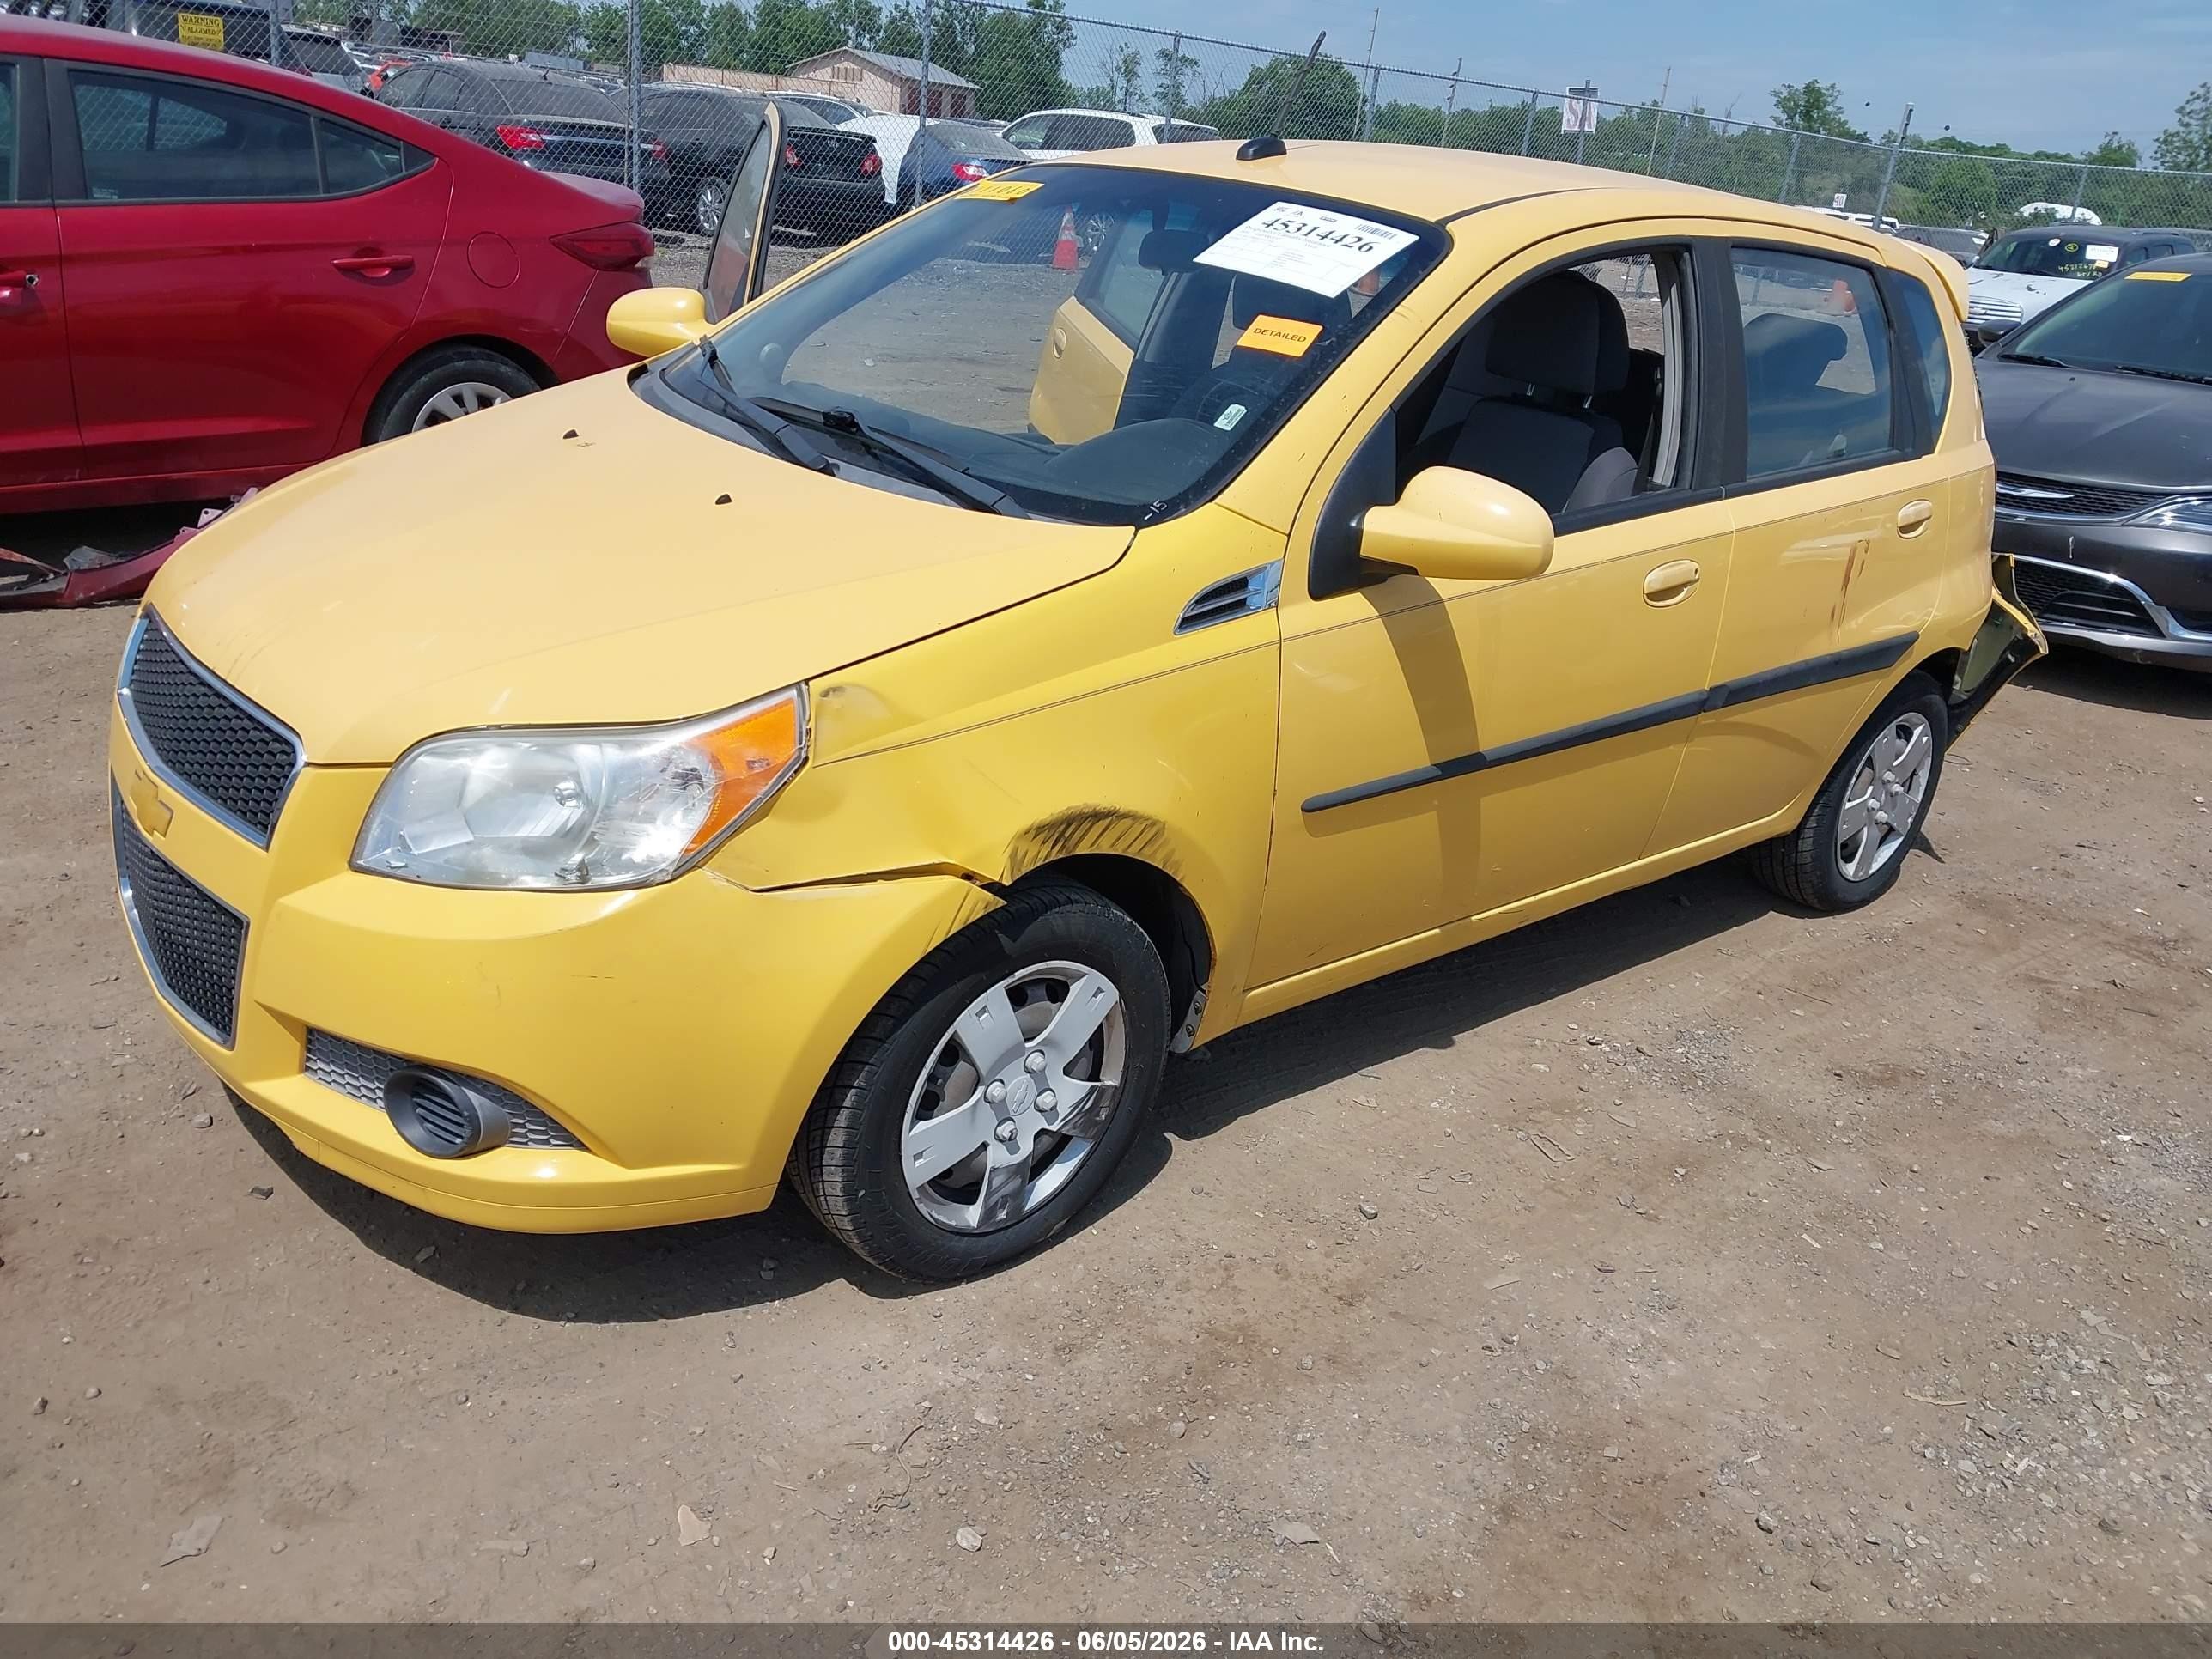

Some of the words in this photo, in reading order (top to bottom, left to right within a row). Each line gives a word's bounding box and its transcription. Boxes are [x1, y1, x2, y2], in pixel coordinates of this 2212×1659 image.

[181, 15, 221, 27] WARNING
[1261, 218, 1381, 252] 45314426
[1254, 327, 1307, 343] DETAILED
